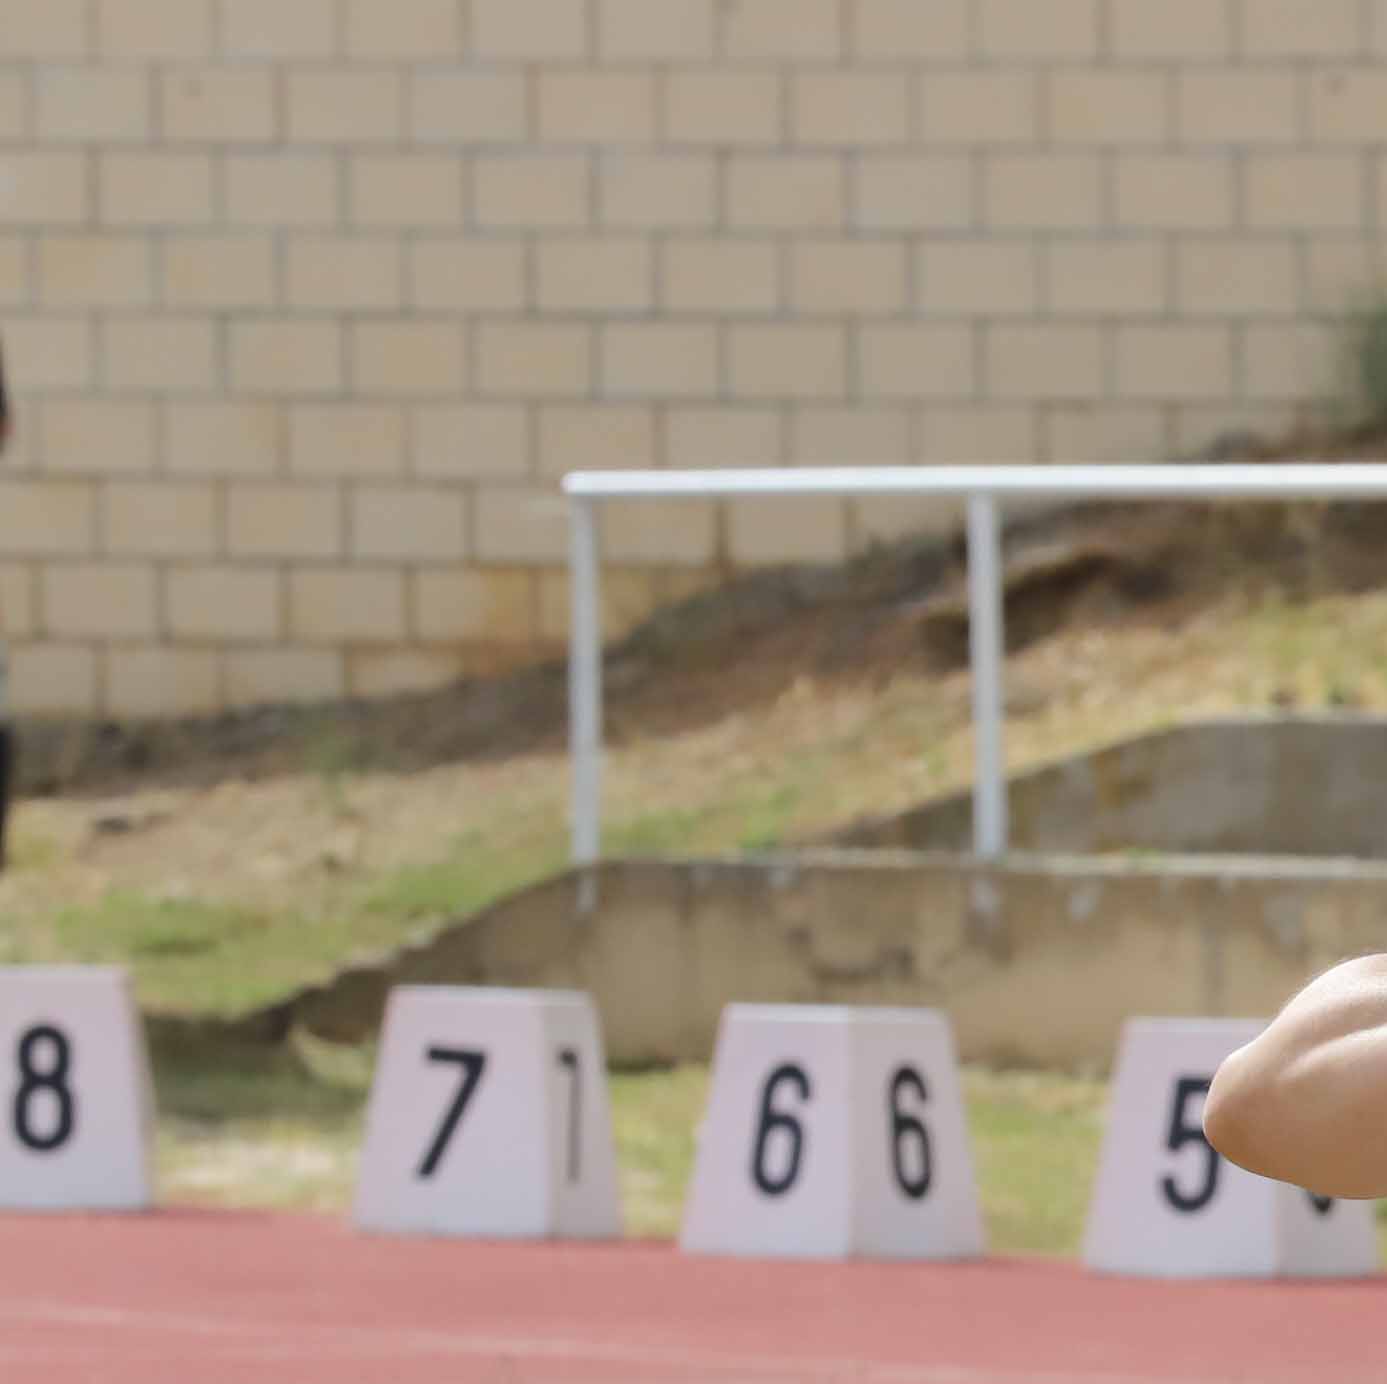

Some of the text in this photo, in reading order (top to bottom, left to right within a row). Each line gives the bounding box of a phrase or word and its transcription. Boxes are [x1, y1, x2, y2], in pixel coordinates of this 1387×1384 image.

[12, 1023, 77, 1152] 8
[413, 1045, 488, 1181] 7
[750, 1061, 813, 1197] 6
[887, 1065, 935, 1200] 6
[1158, 1073, 1221, 1213] 5
